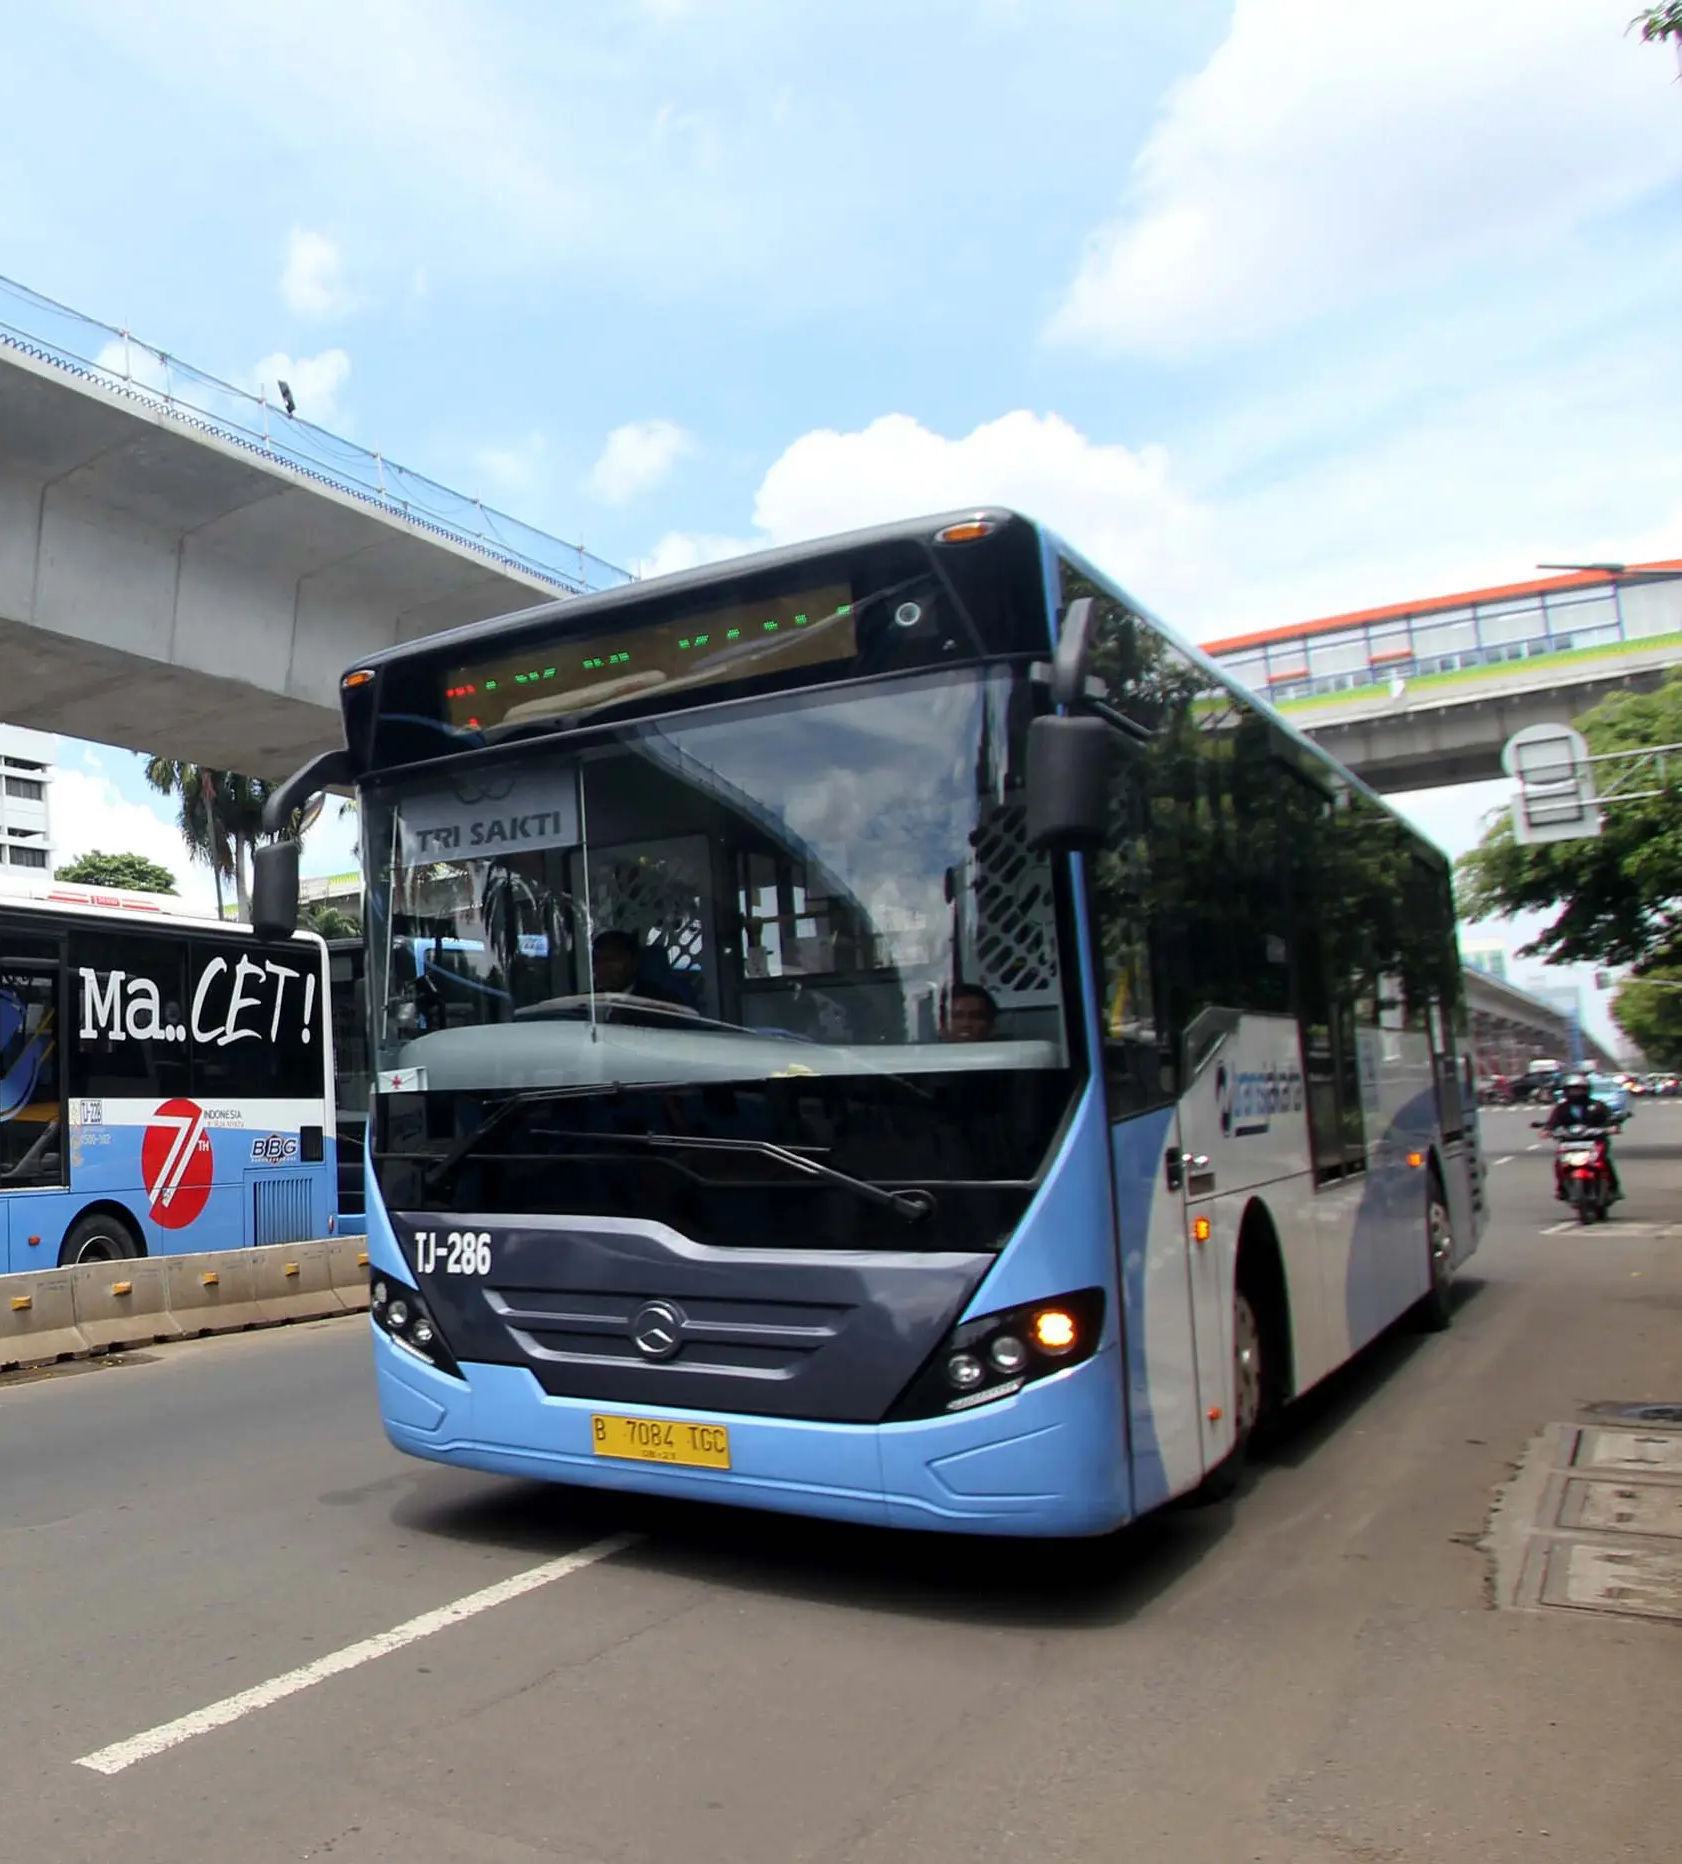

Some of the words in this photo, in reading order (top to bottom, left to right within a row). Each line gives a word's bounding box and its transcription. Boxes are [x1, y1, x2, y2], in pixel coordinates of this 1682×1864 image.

[416, 826, 460, 852] TRI
[470, 811, 561, 846] SAKTI
[203, 1109, 242, 1120] INDONESIA
[250, 1137, 298, 1158] BBG
[414, 1231, 492, 1275] TJ-286
[594, 1417, 607, 1441] B
[626, 1420, 674, 1448] 7084
